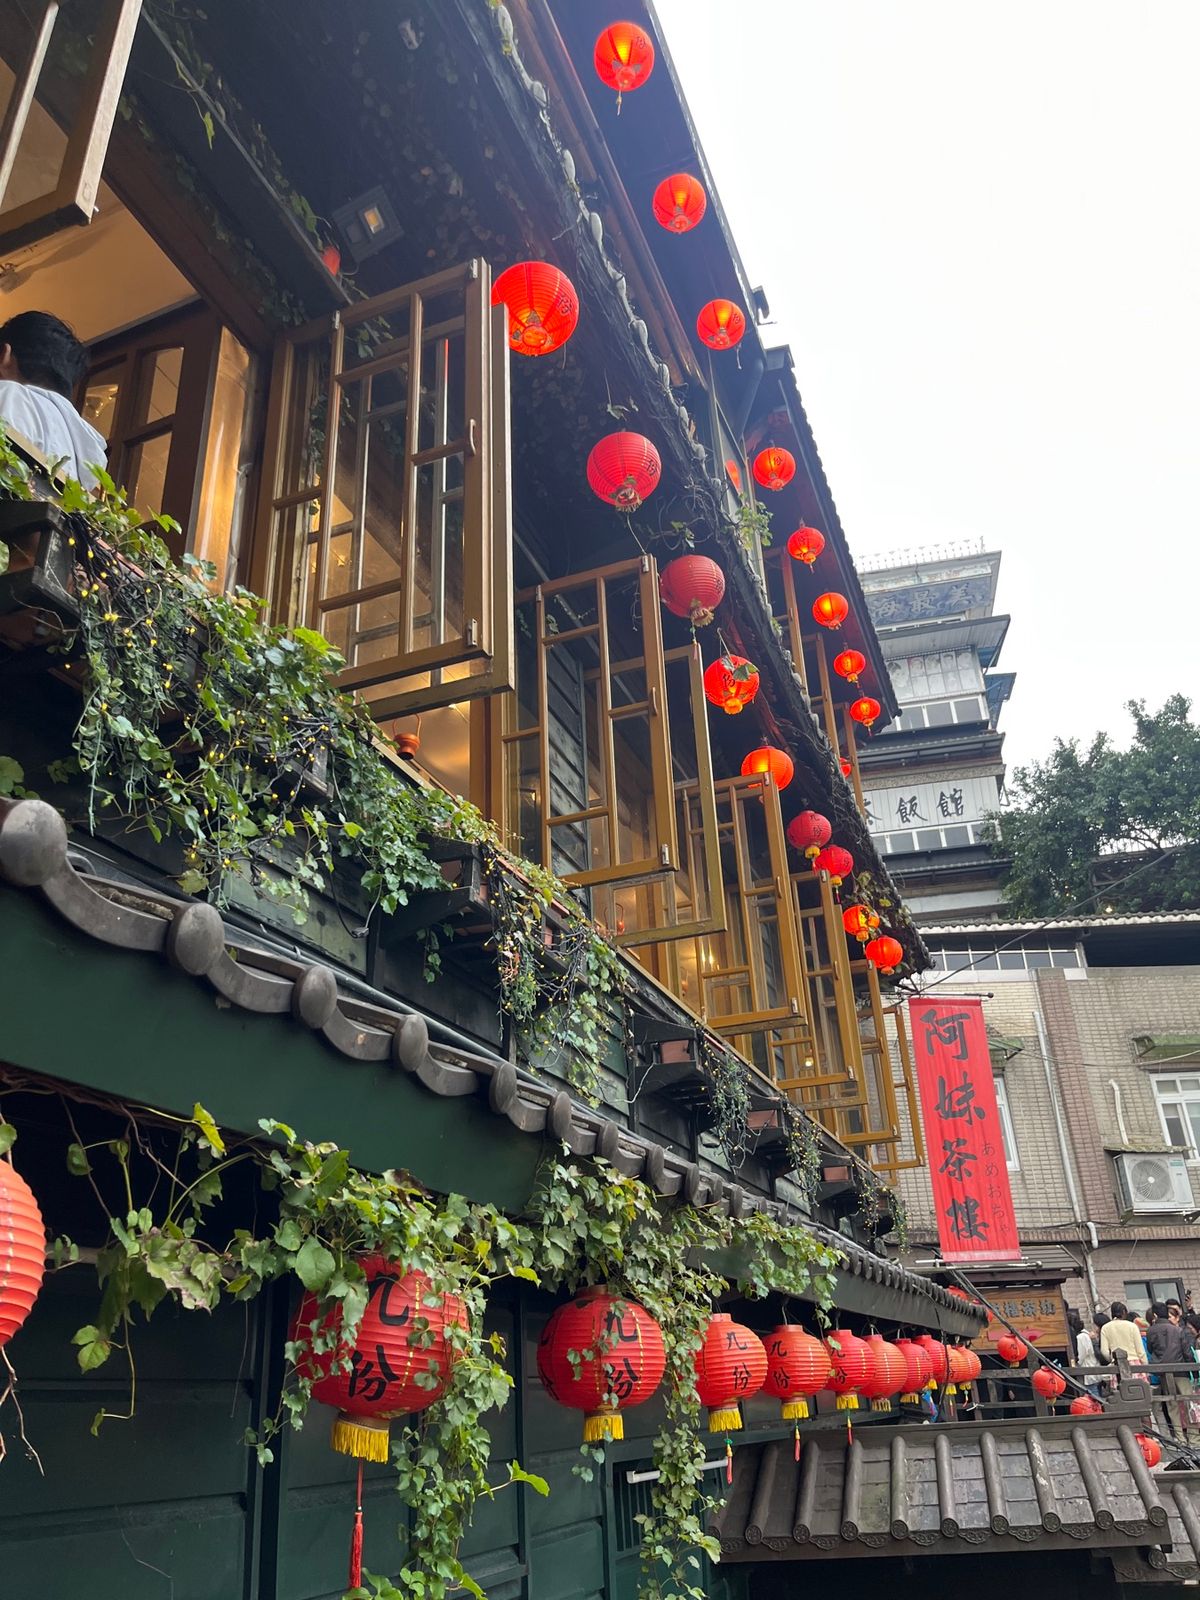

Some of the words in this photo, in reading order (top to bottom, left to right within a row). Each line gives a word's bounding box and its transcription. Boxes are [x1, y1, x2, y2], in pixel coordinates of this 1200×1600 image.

[920, 1008, 990, 1242] 阿妹茶樓
[348, 1273, 410, 1402] 九份
[603, 1308, 640, 1400] 九份
[726, 1331, 752, 1391] 九份
[770, 1340, 791, 1390] 九份
